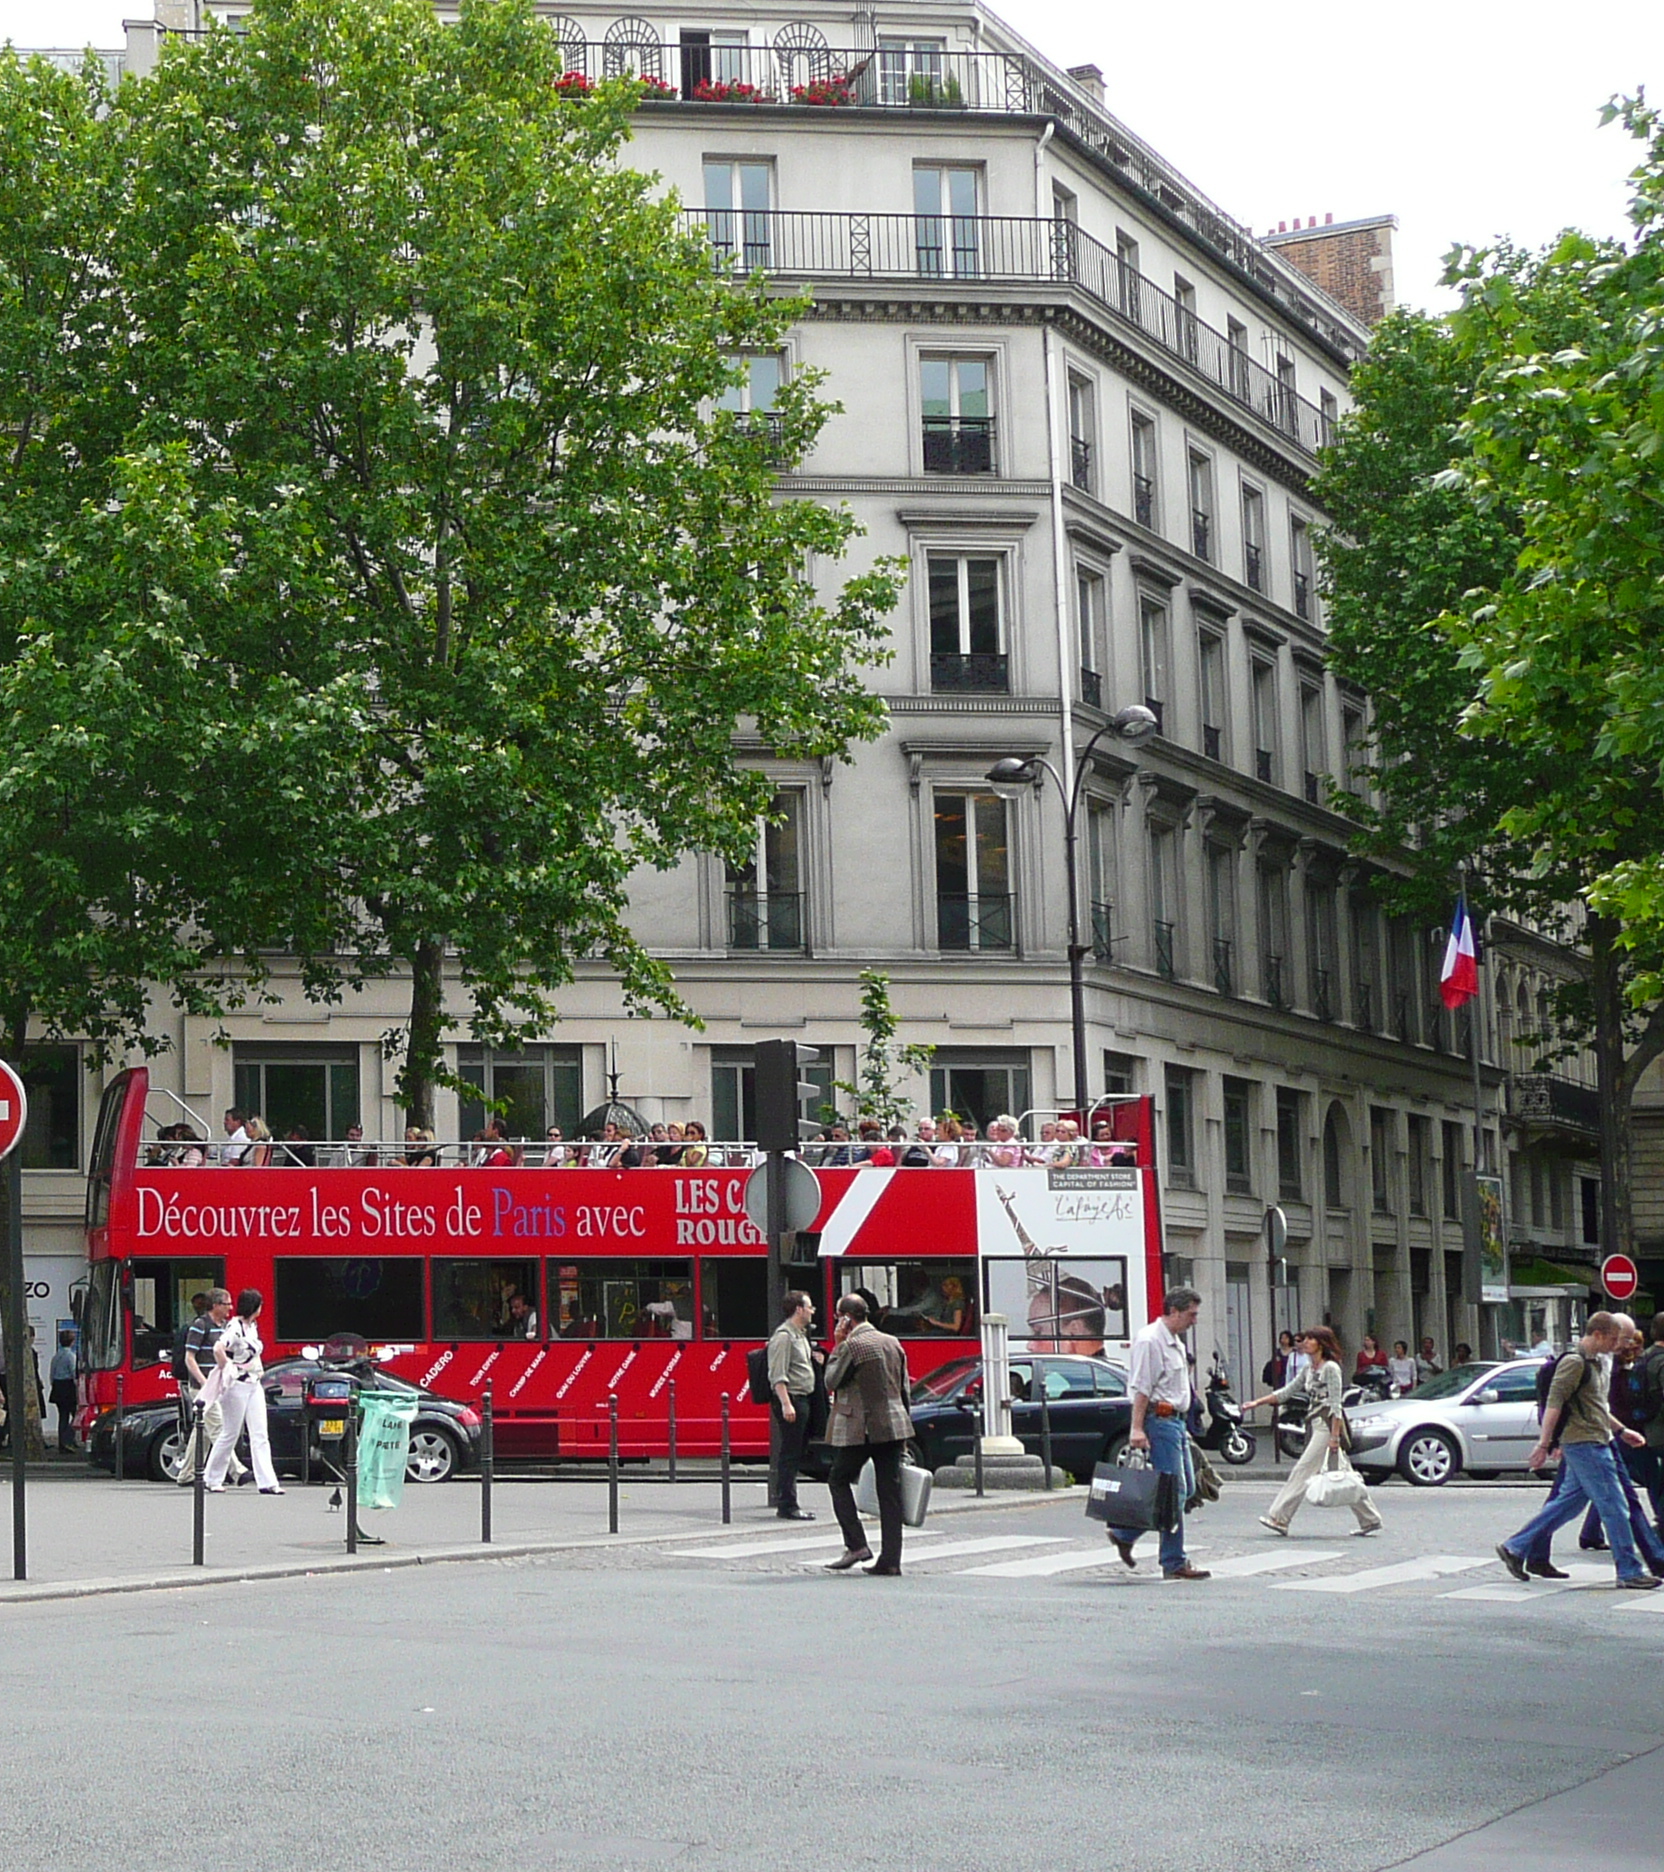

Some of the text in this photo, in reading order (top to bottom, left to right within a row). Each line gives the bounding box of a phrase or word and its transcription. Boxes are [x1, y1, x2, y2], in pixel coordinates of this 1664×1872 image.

[136, 1185, 646, 1237] Découvrez les Sites de Paris avec
[674, 1179, 746, 1214] LES C
[419, 1350, 454, 1389] CADERO
[468, 1351, 500, 1387] TOUR EIFFEL
[508, 1376, 526, 1398] CHAMP
[530, 1350, 546, 1369] MARS
[555, 1382, 570, 1399] QUAI
[572, 1350, 592, 1376] LOUVRE
[607, 1350, 637, 1389] NOTRE DAME
